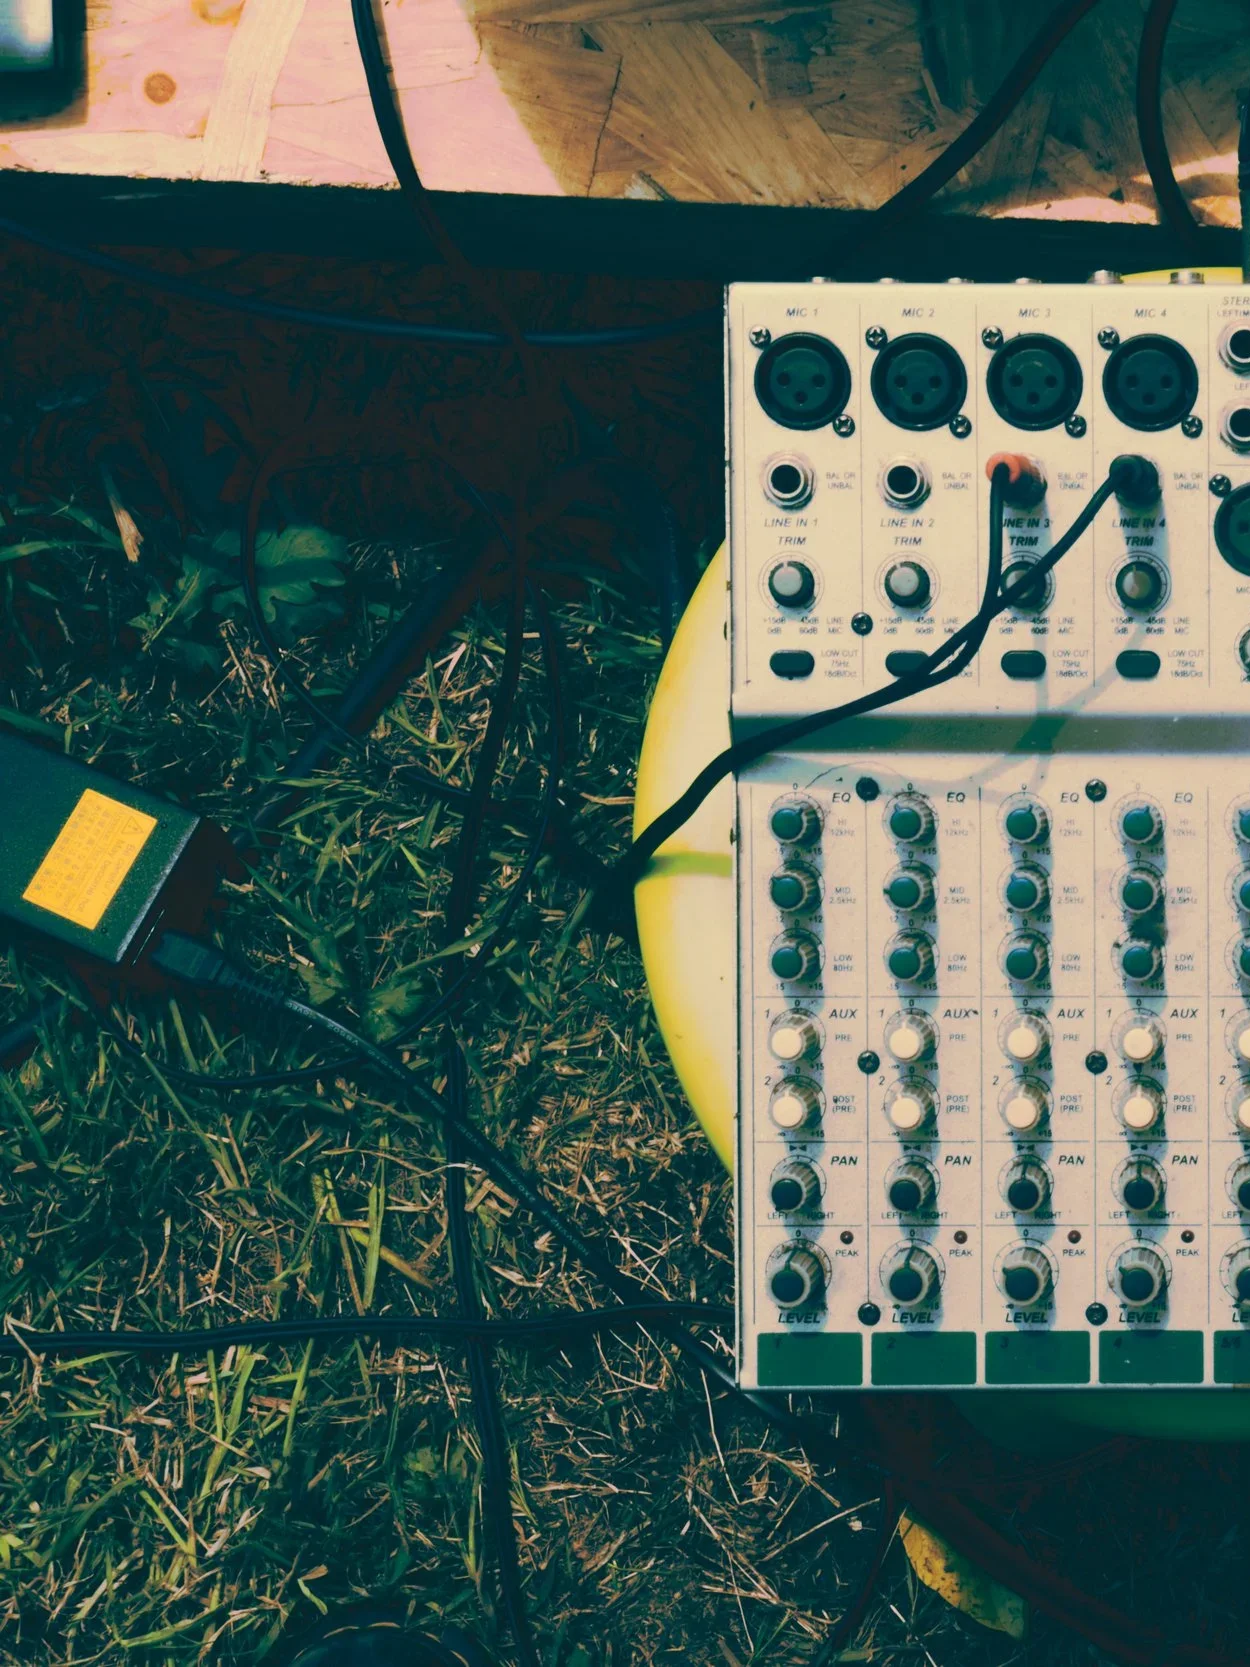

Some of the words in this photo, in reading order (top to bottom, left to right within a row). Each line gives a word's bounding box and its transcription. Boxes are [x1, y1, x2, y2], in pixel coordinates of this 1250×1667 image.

[785, 307, 807, 317] MIC
[812, 307, 818, 317] 1
[902, 307, 924, 318] MIC
[928, 307, 935, 318] 2
[1018, 307, 1040, 319] MIC
[1045, 307, 1051, 319] 3
[1134, 308, 1156, 319] MIC
[1160, 308, 1167, 319] 4
[764, 518, 791, 527] LINE
[796, 518, 808, 527] IN
[880, 518, 907, 528] LINE
[912, 518, 923, 527] IN
[928, 518, 935, 527] 2
[1027, 518, 1040, 528] IN
[1044, 518, 1051, 528] 3
[1112, 518, 1139, 528] LINE
[1144, 518, 1156, 528] IN
[1159, 519, 1166, 528] 4
[778, 536, 807, 545] TRIM
[894, 536, 922, 545] TRIM
[1009, 536, 1038, 546] TRIM
[1125, 536, 1154, 546] TRIM
[832, 792, 851, 803] EQ
[947, 792, 965, 803] EQ
[1060, 792, 1080, 803] EQ
[1174, 792, 1193, 803] EQ
[833, 954, 853, 962] LOW
[948, 954, 967, 962] LOW
[829, 1009, 857, 1018] AUX
[943, 1009, 971, 1018] AUX
[1057, 1009, 1085, 1018] AUX
[1170, 1009, 1198, 1018] AUX
[764, 1076, 771, 1086] 2
[832, 1095, 855, 1103] POST
[946, 1095, 969, 1103] POST
[1173, 1095, 1196, 1103] POST
[830, 1156, 858, 1165] PAN
[944, 1156, 972, 1165] PAN
[1058, 1155, 1085, 1165] PAN
[1171, 1155, 1198, 1165] PAN
[767, 1211, 790, 1220] LEFT
[807, 1211, 835, 1220] RIGHT
[881, 1211, 904, 1220] LEFT
[921, 1211, 949, 1220] RIGHT
[995, 1211, 1017, 1219] LEFT
[1034, 1211, 1062, 1219] RIGHT
[1108, 1211, 1131, 1219] LEFT
[1148, 1211, 1176, 1219] RIGHT
[1221, 1211, 1244, 1219] LEFT
[835, 1249, 859, 1257] PEAK
[949, 1249, 973, 1257] PEAK
[1062, 1249, 1086, 1257] PEAK
[778, 1313, 821, 1323] LEVEL
[892, 1312, 935, 1323] LEVEL
[1005, 1312, 1048, 1323] LEVEL
[1118, 1312, 1161, 1323] LEVEL
